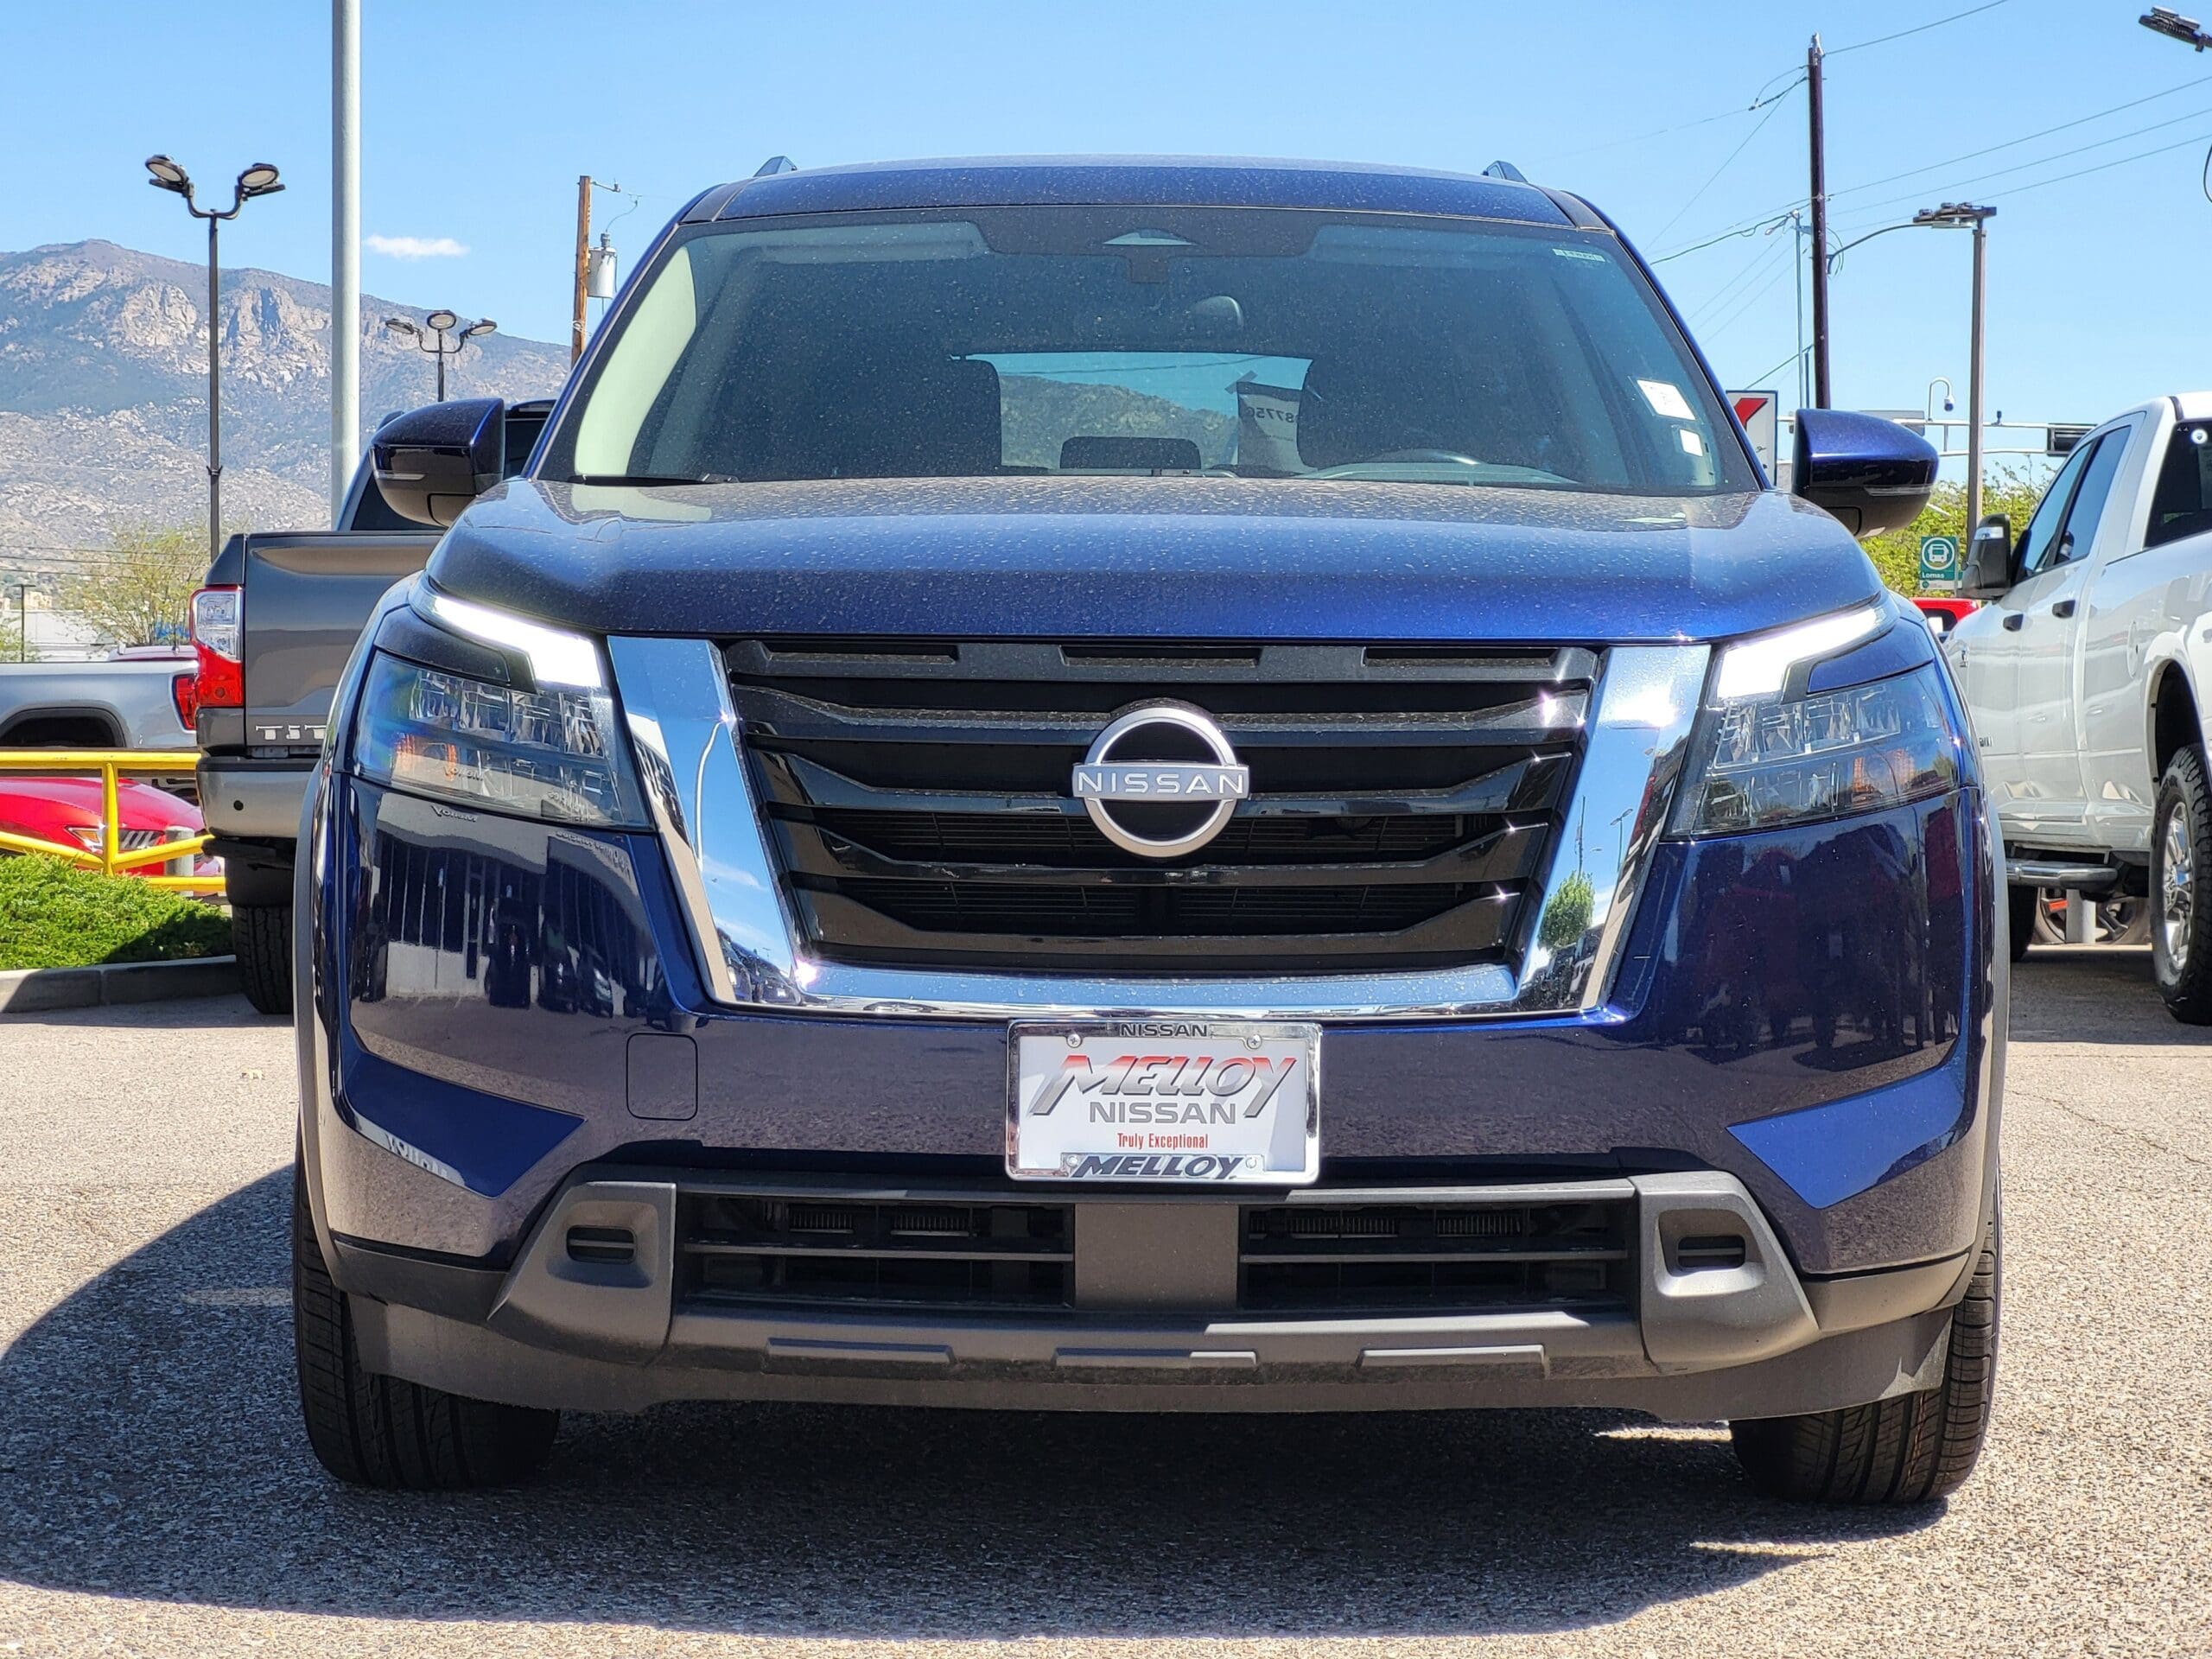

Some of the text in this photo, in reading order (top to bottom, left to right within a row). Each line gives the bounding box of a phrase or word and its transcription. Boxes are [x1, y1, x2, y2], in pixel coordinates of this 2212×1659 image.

[1078, 772, 1243, 794] NISSAN
[1120, 1023, 1209, 1038] NISSAN
[1029, 1054, 1297, 1118] MELLOY
[1089, 1101, 1236, 1124] NISSAN
[1116, 1133, 1209, 1150] Truly Exceptional
[1069, 1154, 1244, 1179] MELLOY
